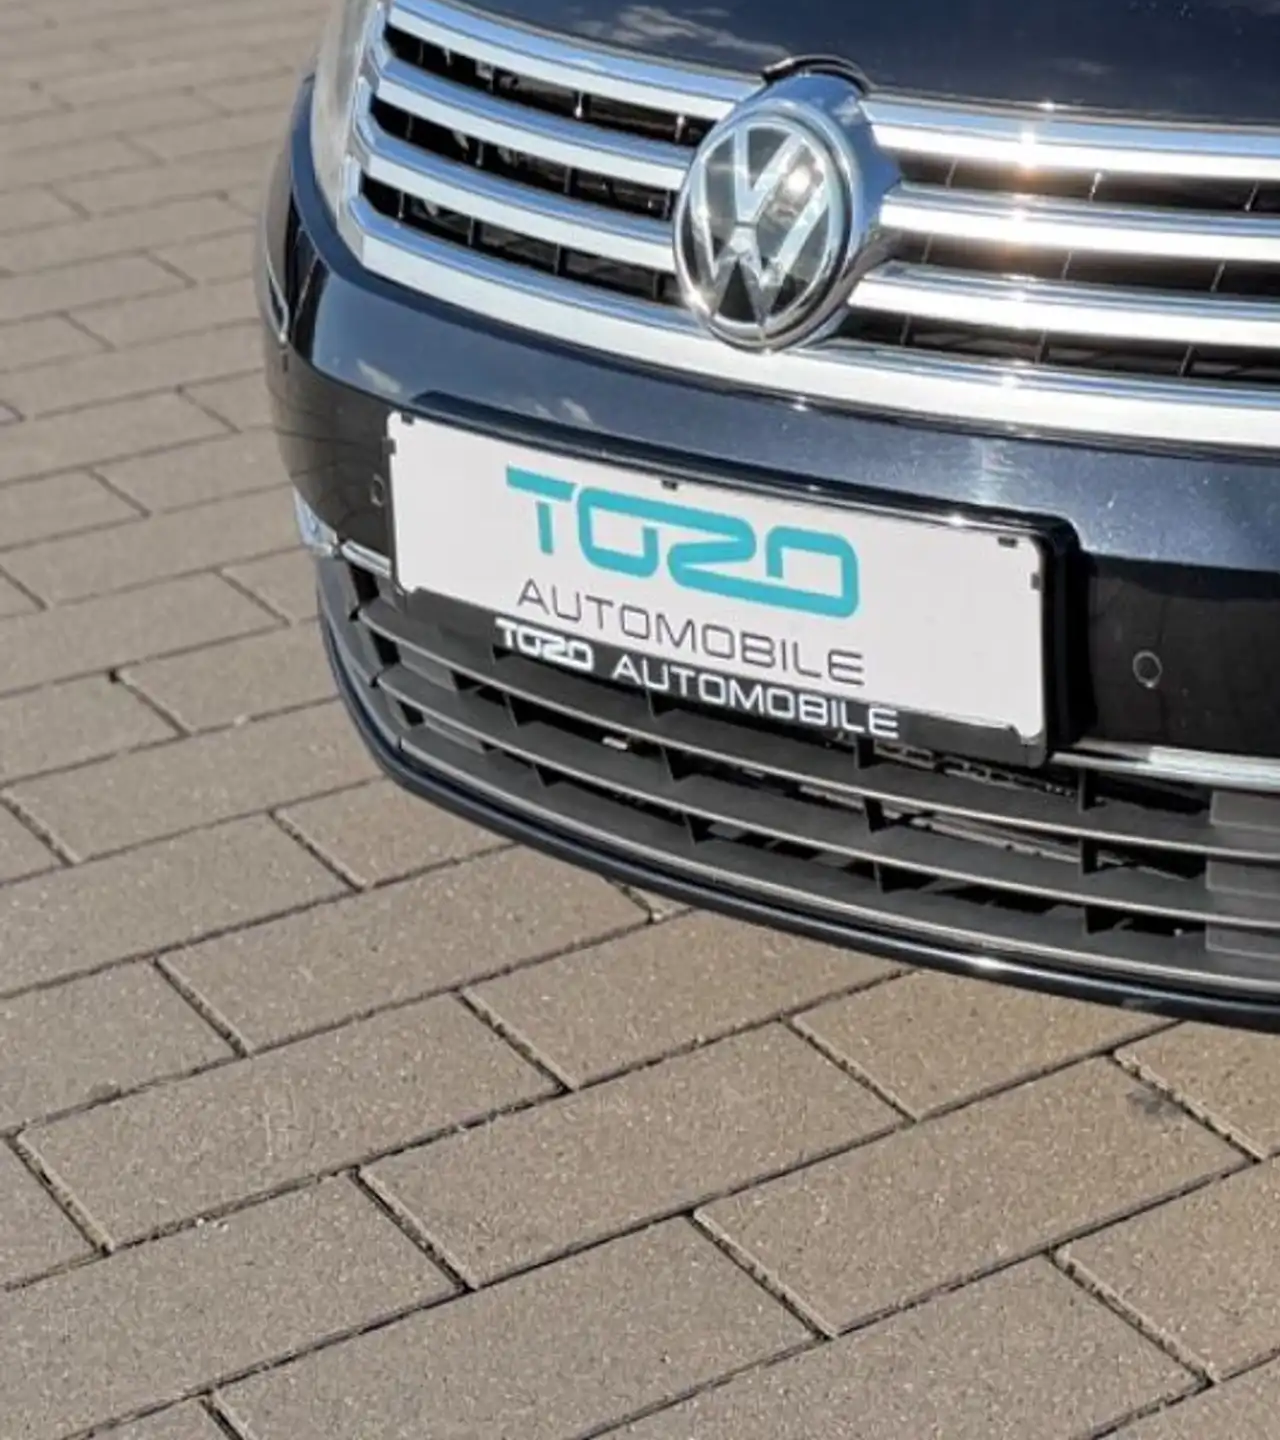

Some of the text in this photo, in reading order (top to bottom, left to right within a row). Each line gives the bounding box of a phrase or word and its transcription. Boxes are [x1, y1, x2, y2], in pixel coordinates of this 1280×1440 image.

[686, 122, 832, 328] VW
[505, 465, 860, 620] TOZO
[494, 616, 901, 740] TOZO AUTOMOBILE
[516, 577, 866, 688] AUTOMOBILE
